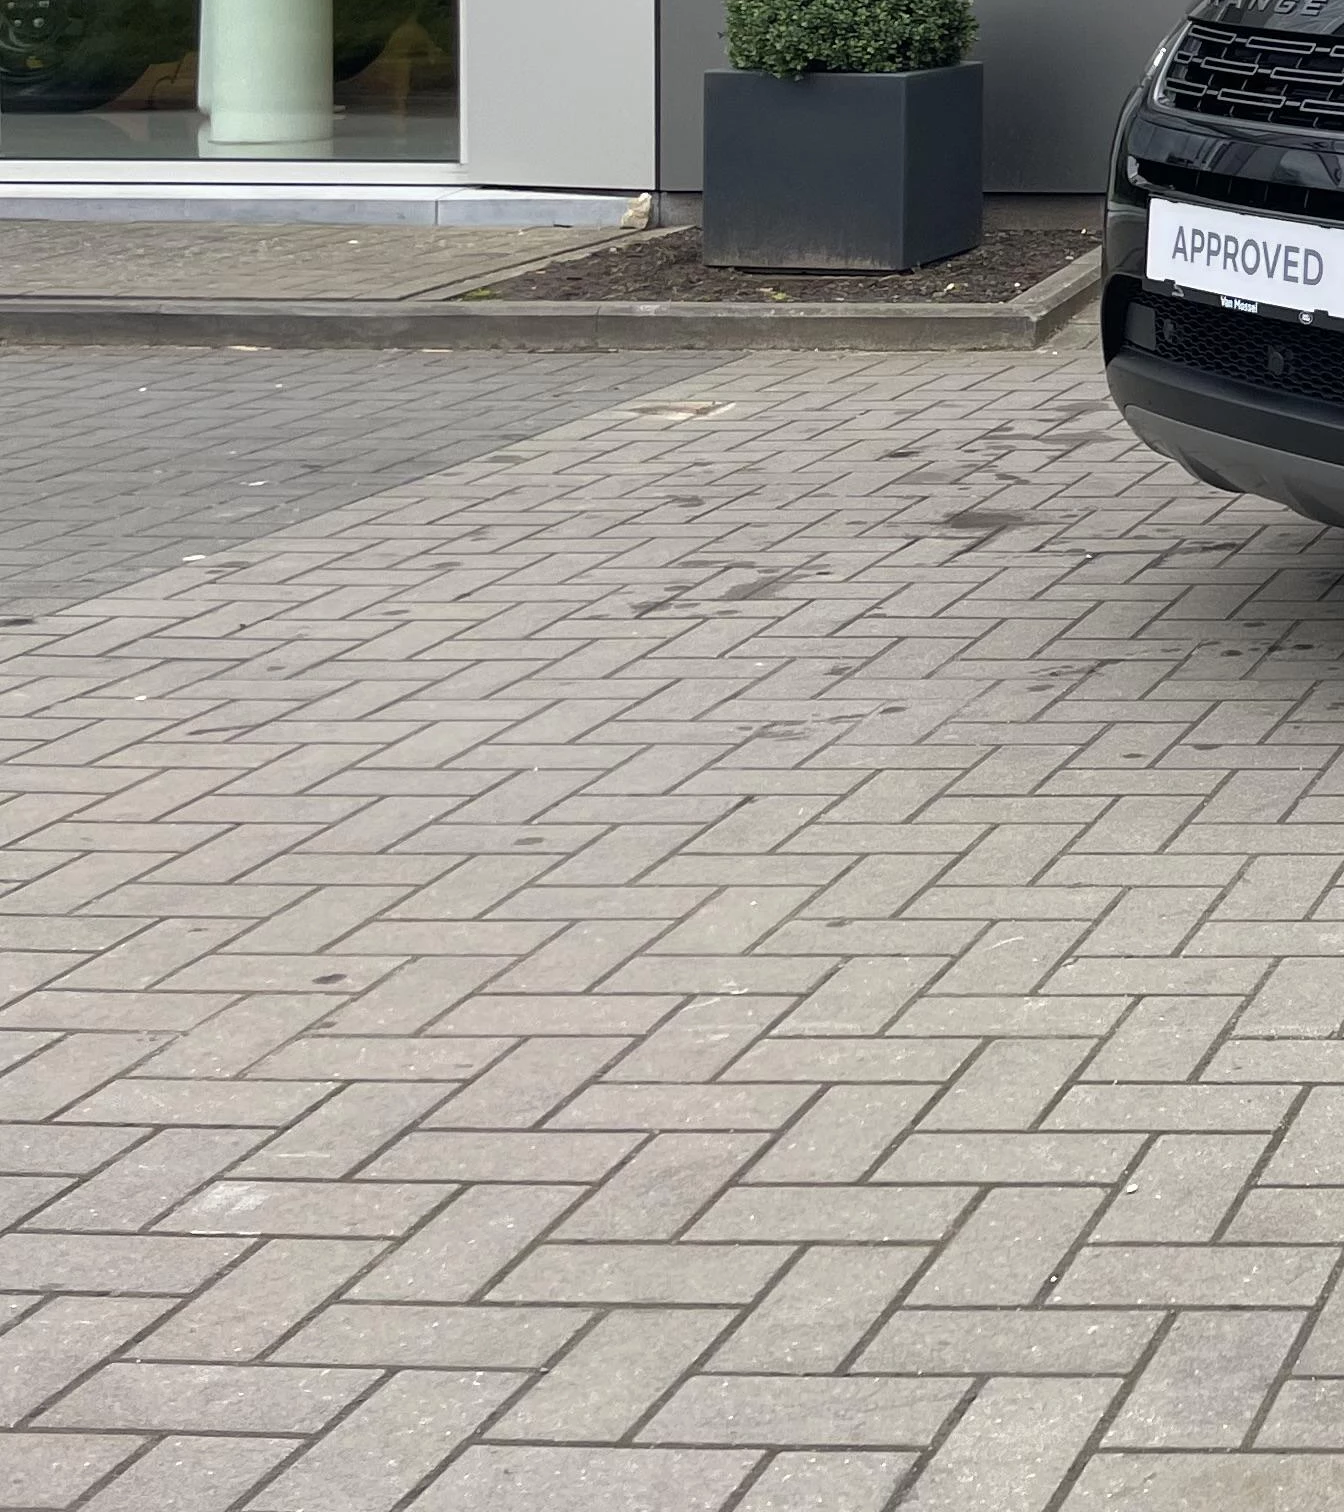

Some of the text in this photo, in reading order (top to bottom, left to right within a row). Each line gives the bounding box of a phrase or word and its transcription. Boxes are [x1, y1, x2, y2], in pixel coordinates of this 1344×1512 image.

[1172, 225, 1324, 286] APPROVED
[1220, 295, 1258, 314] Van Mossel
